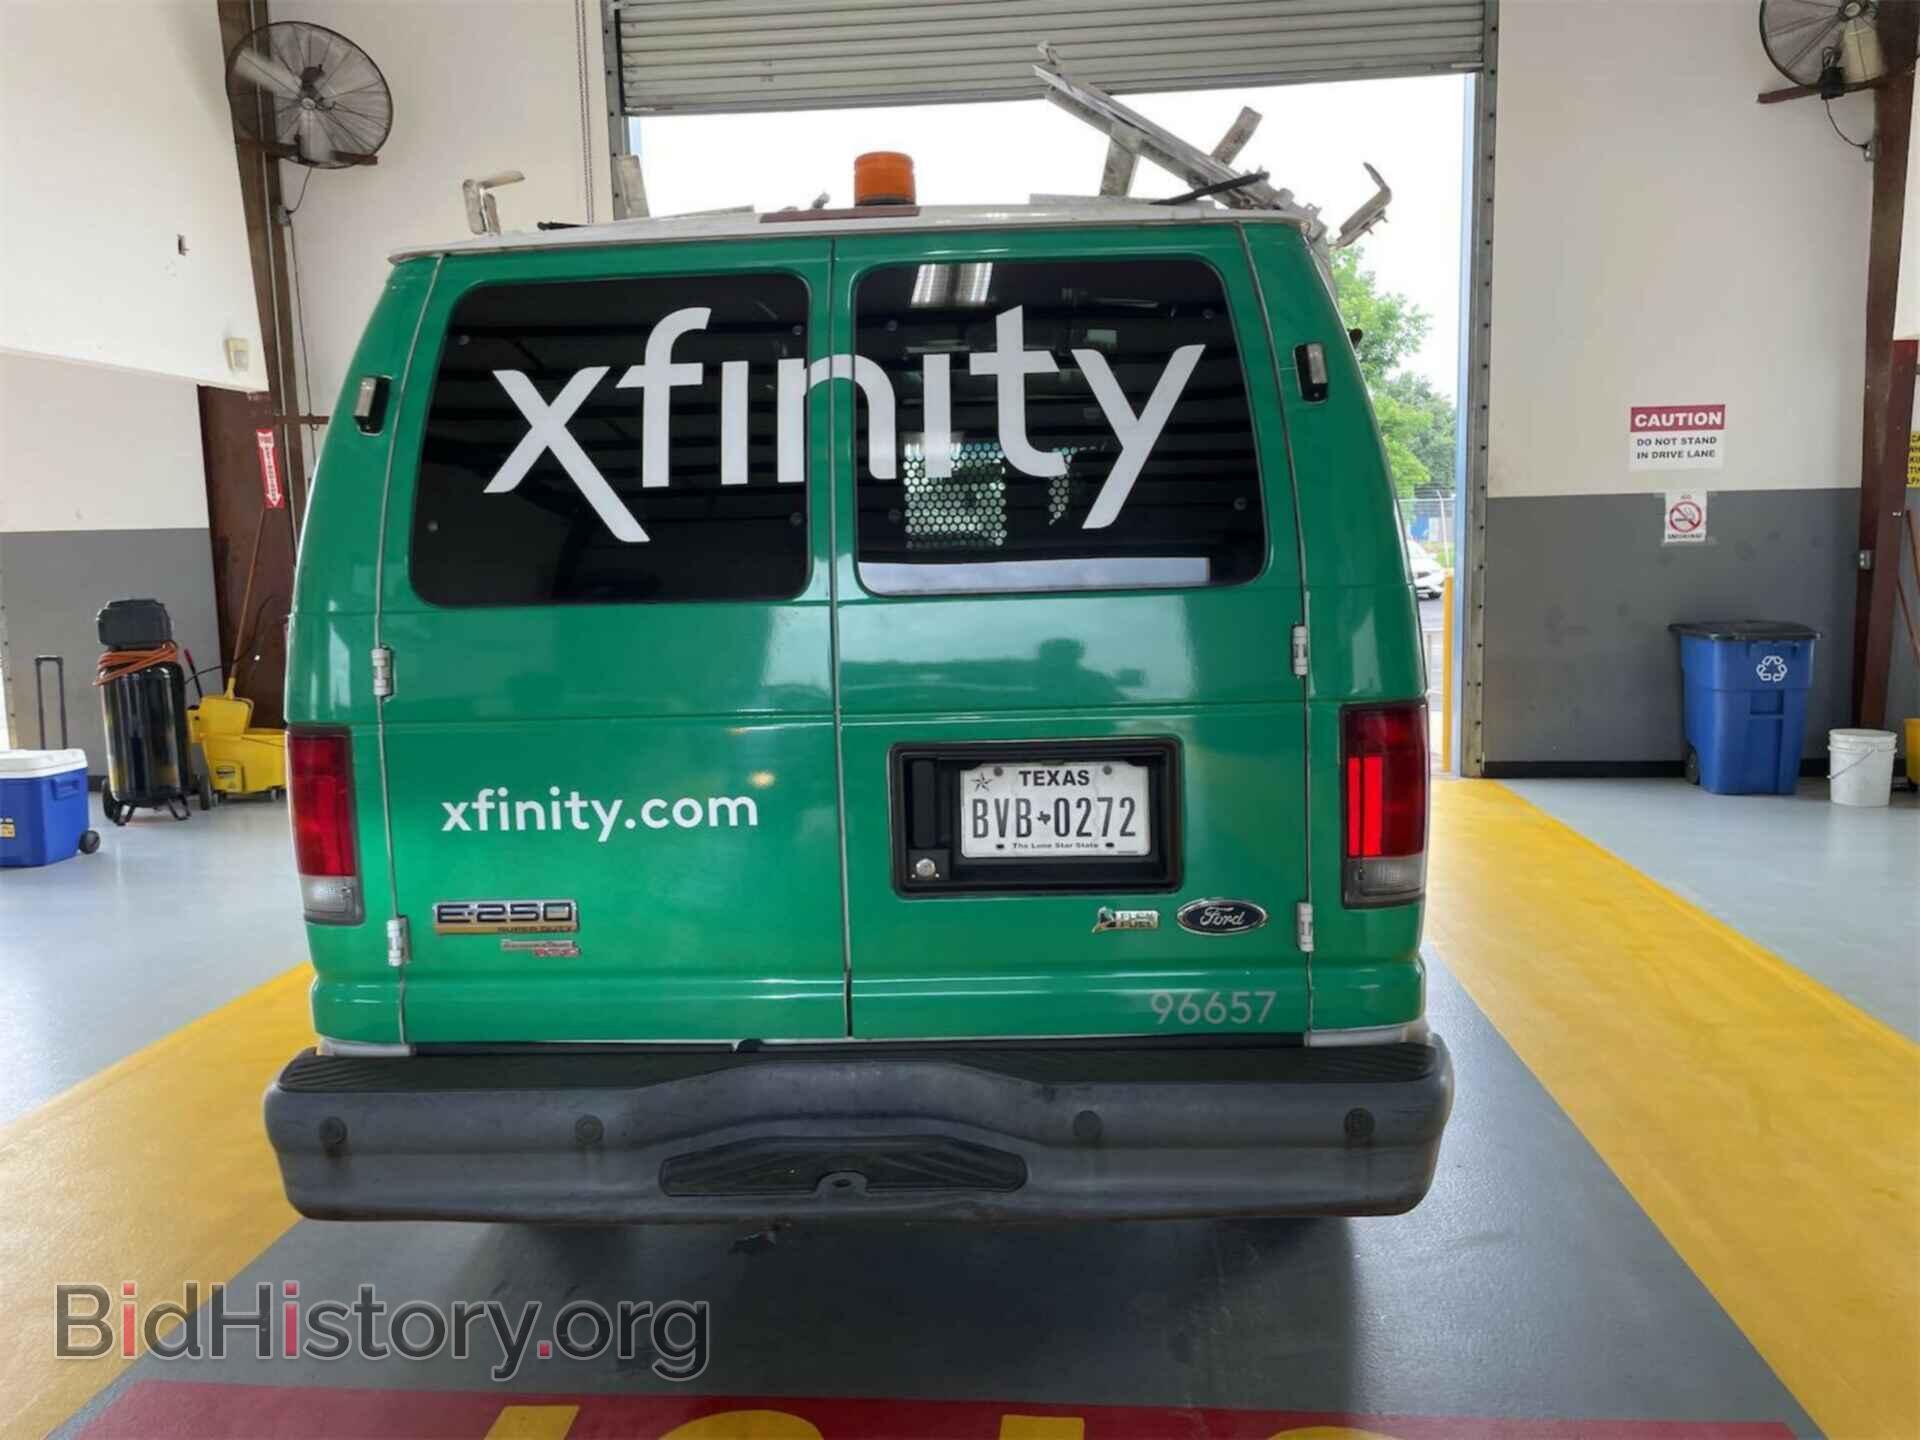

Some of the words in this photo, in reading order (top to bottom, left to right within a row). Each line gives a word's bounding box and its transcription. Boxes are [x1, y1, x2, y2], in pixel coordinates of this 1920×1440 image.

[483, 305, 1207, 543] xfinity
[1634, 411, 1722, 428] CAUTION
[1636, 438, 1652, 447] DO
[1655, 438, 1677, 446] NOT
[1681, 436, 1717, 445] STAND
[1636, 451, 1648, 460] IN
[1651, 450, 1682, 459] DRIVE
[1687, 449, 1716, 458] LANE
[1019, 769, 1090, 786] TEXAS
[441, 786, 759, 843] xfinity.com
[972, 798, 1032, 838] BVB
[1054, 796, 1136, 837] 0272
[437, 904, 573, 923] E-250
[1200, 906, 1246, 926] Ford
[1150, 990, 1277, 1024] 96657
